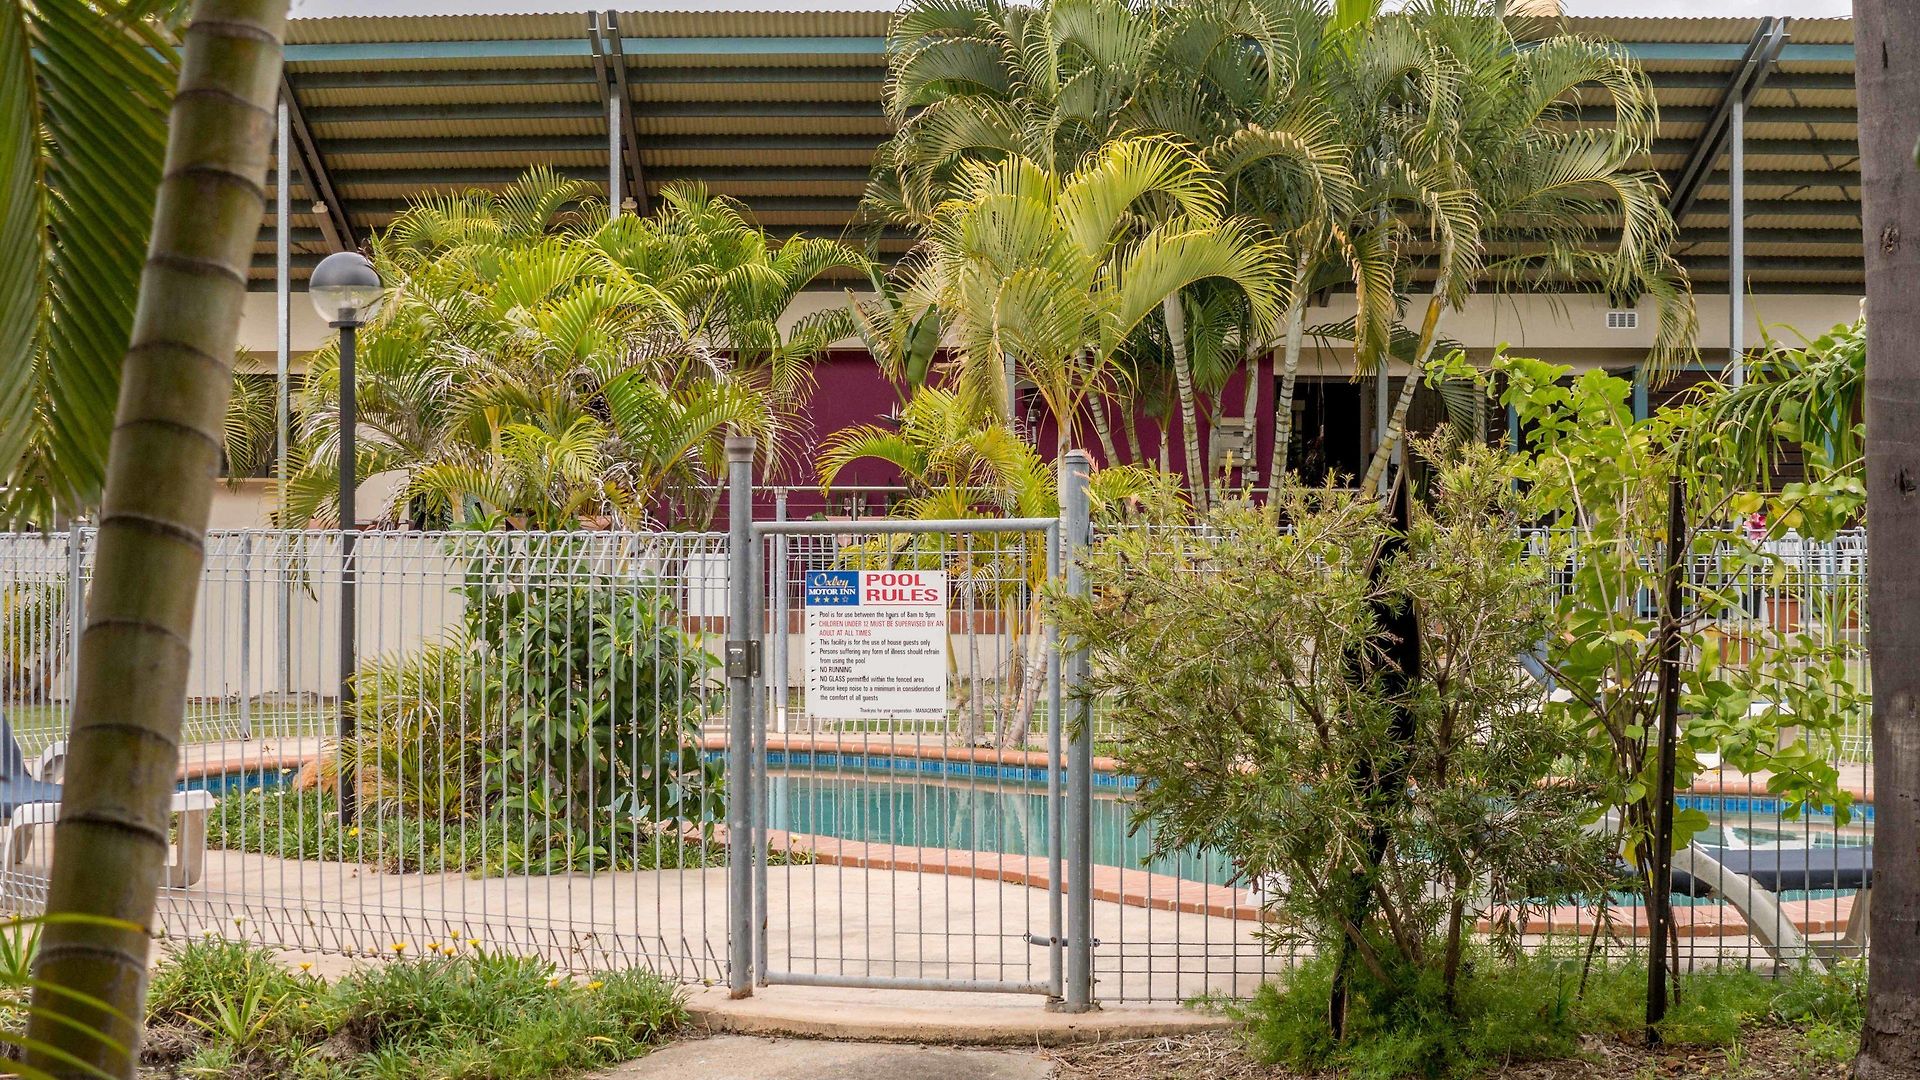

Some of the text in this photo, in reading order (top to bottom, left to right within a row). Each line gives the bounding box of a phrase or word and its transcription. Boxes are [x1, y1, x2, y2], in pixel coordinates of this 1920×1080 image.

[814, 573, 848, 588] Oxley
[866, 574, 926, 586] POOL
[866, 589, 938, 601] RULES
[925, 611, 936, 619] 9pm
[831, 639, 846, 647] facility
[920, 639, 930, 647] only
[839, 648, 861, 656] suffering
[854, 657, 866, 665] pool
[836, 684, 848, 692] keep
